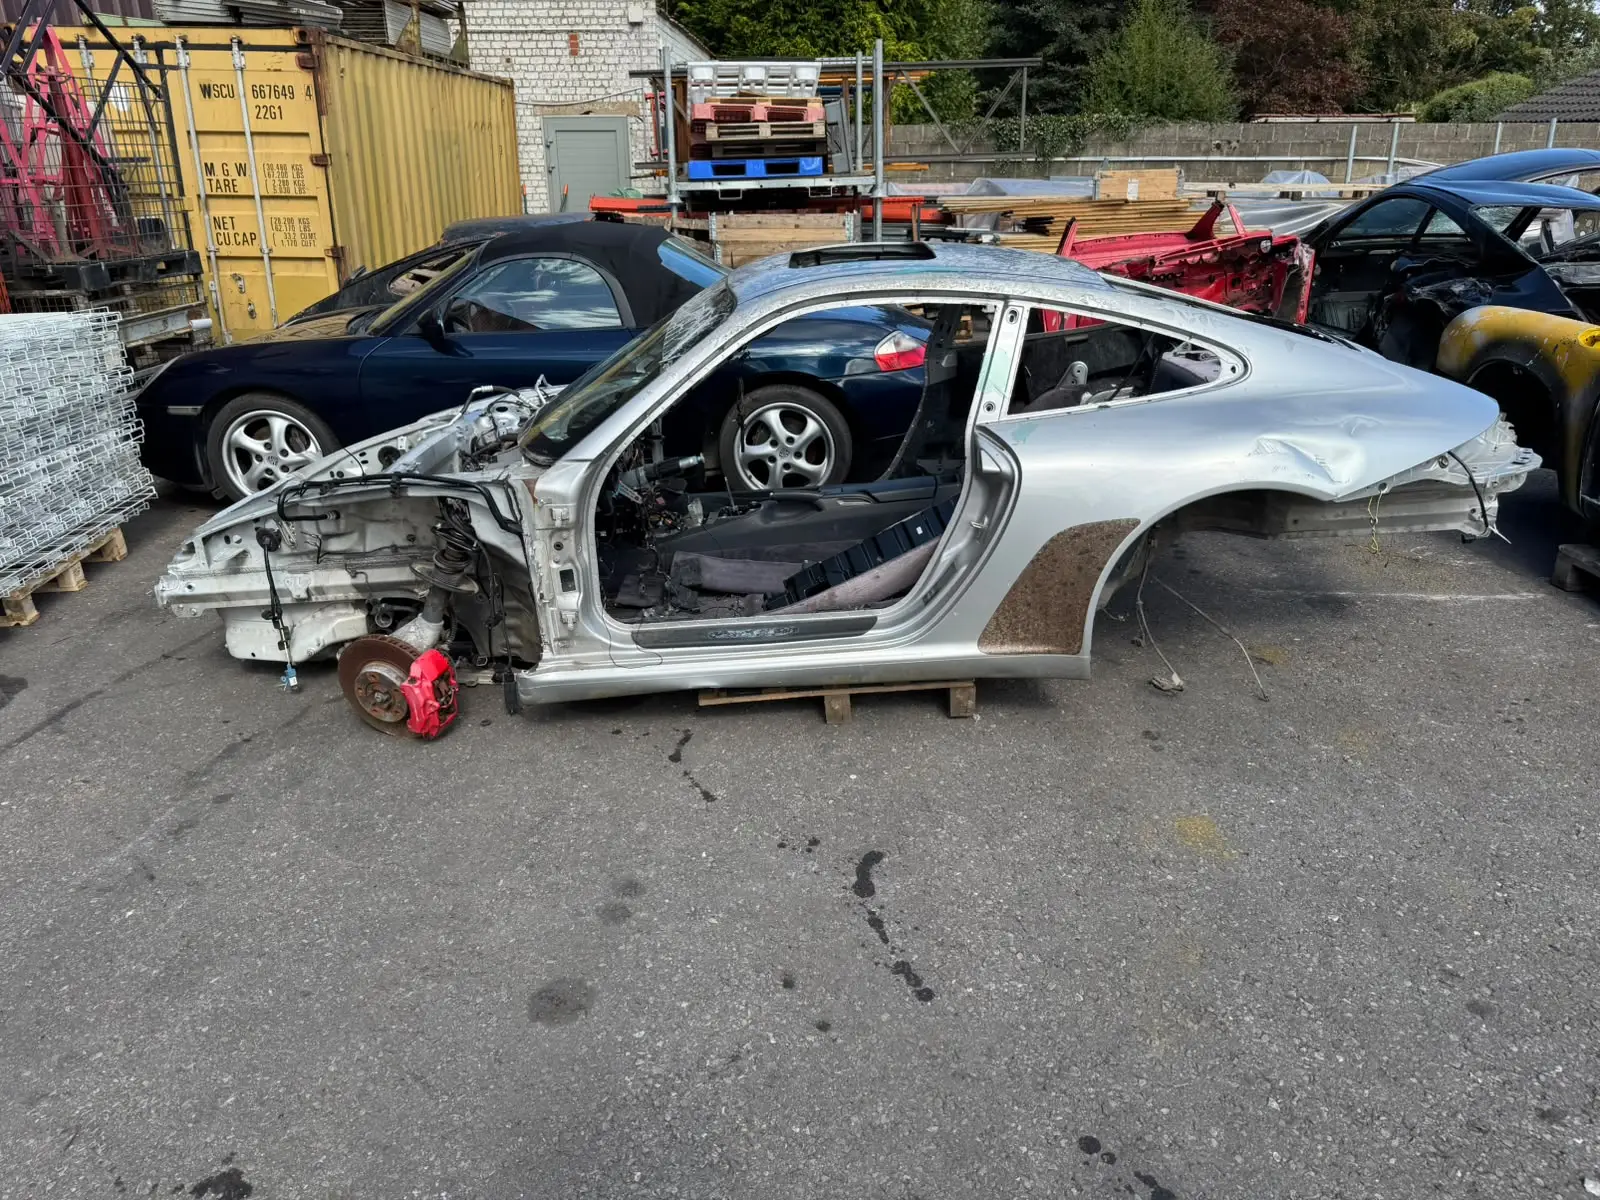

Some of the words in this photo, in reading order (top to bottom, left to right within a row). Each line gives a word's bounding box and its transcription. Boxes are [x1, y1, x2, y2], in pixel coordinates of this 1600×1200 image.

[200, 84, 235, 100] WSCU
[252, 84, 295, 100] 667649
[306, 85, 312, 100] 4
[254, 105, 283, 120] 22G1
[206, 178, 238, 193] TARE
[213, 216, 235, 230] NET
